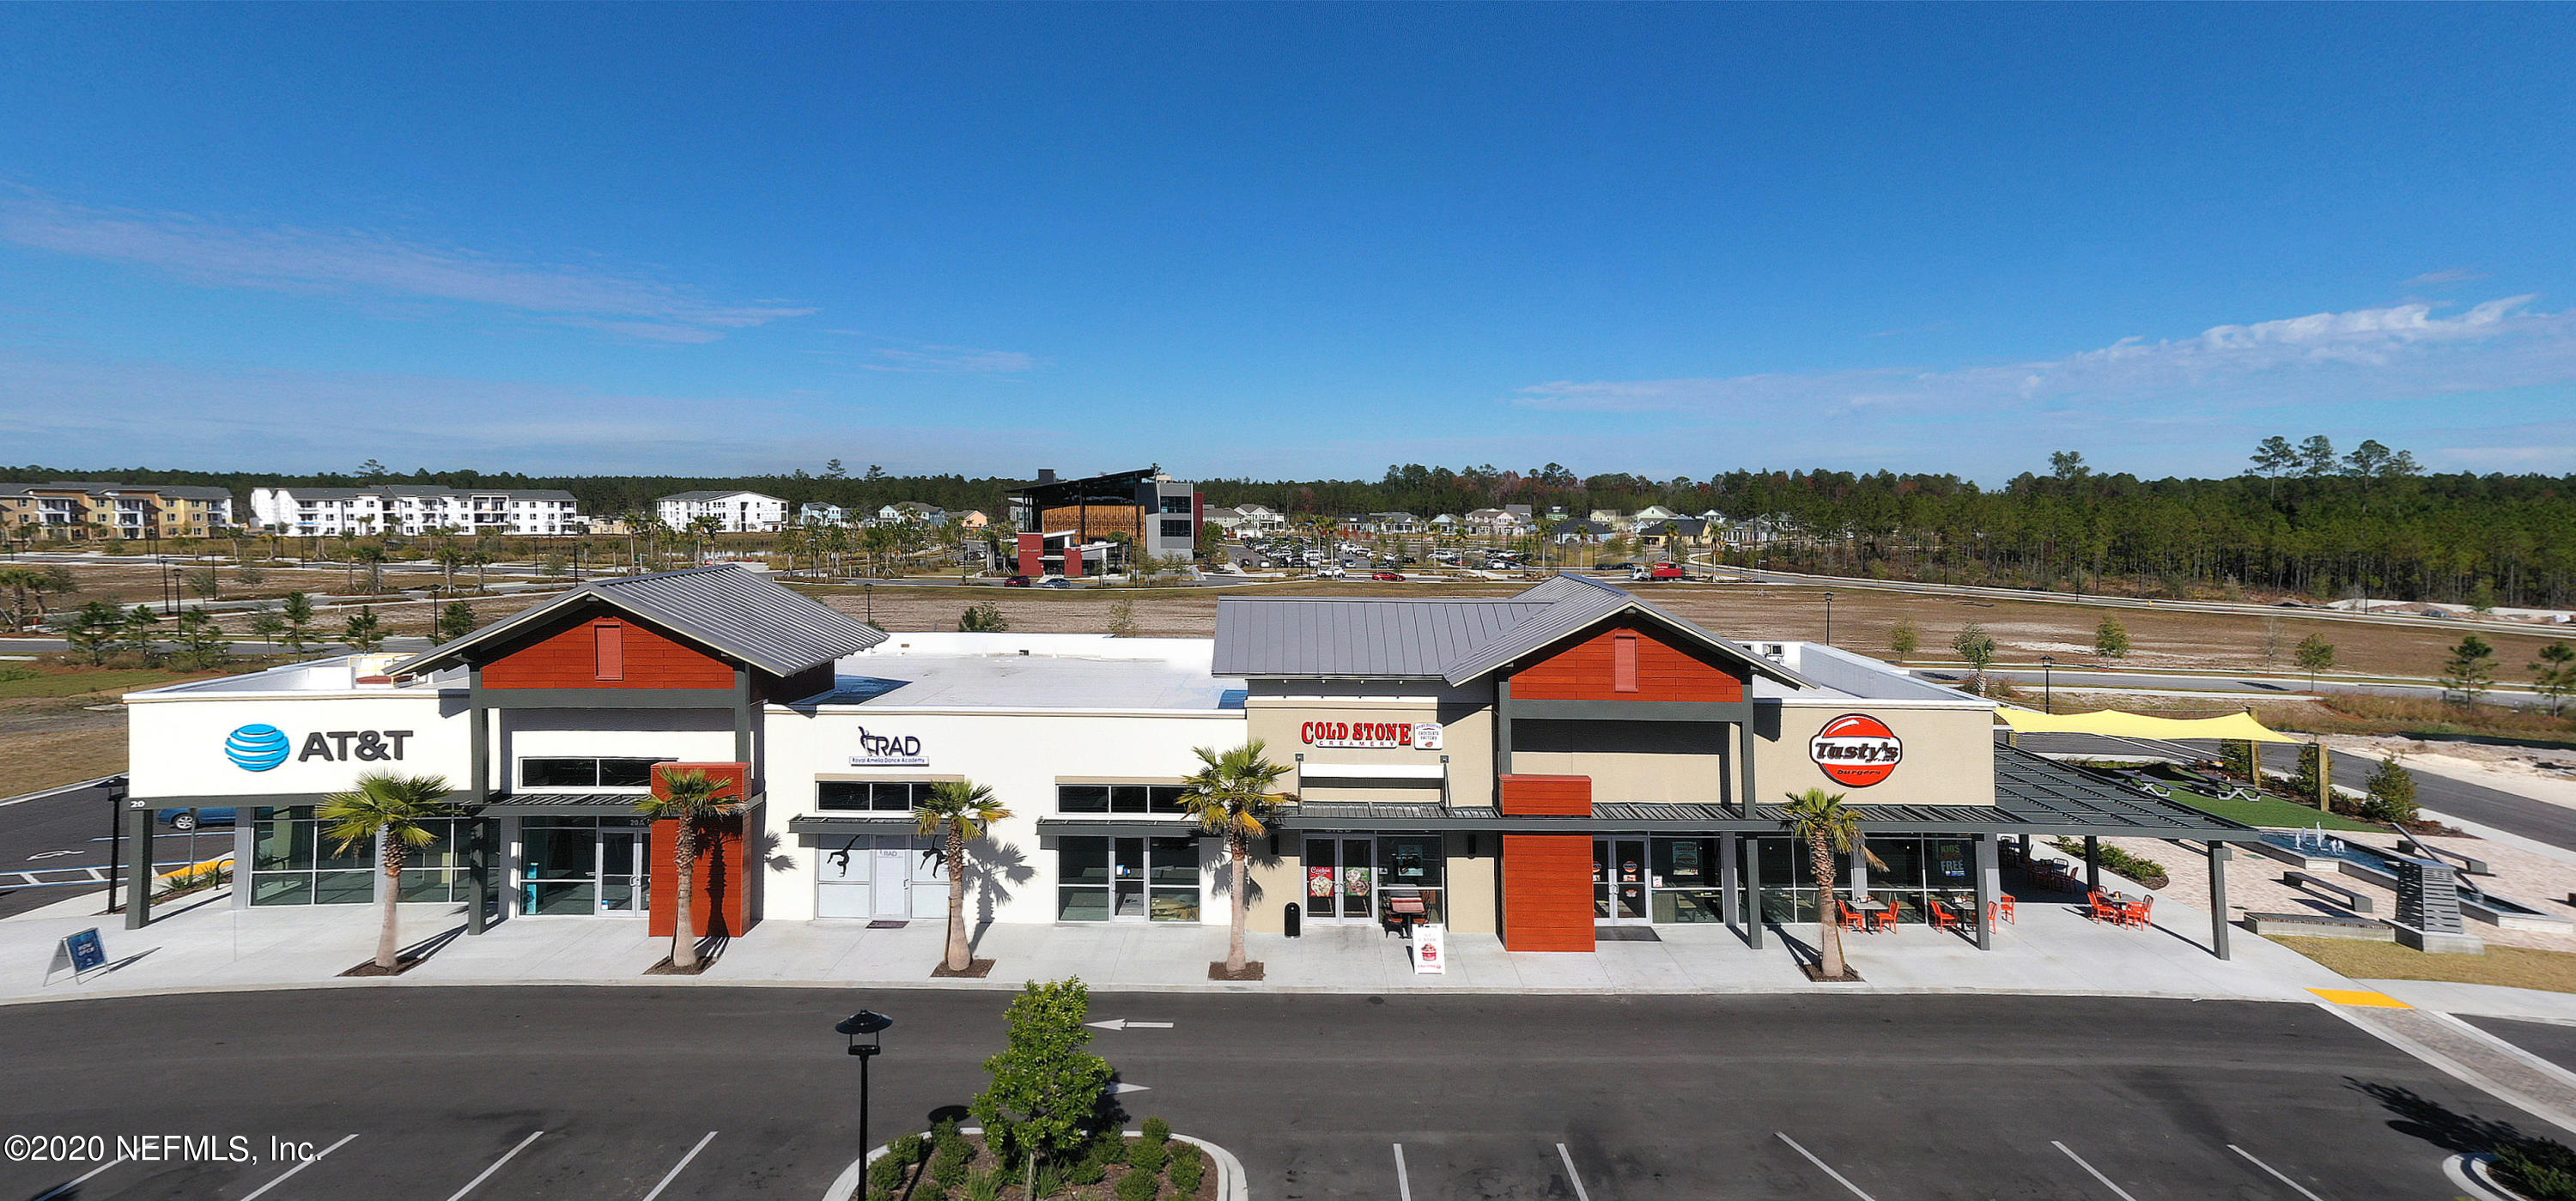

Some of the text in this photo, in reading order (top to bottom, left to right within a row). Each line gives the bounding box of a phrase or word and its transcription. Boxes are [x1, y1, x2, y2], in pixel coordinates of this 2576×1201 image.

[1301, 721, 1412, 746] COLD STONE
[297, 730, 414, 762] AT&T
[876, 736, 921, 756] RAD
[1814, 742, 1899, 763] Tasty's
[1941, 859, 1965, 872] FREE
